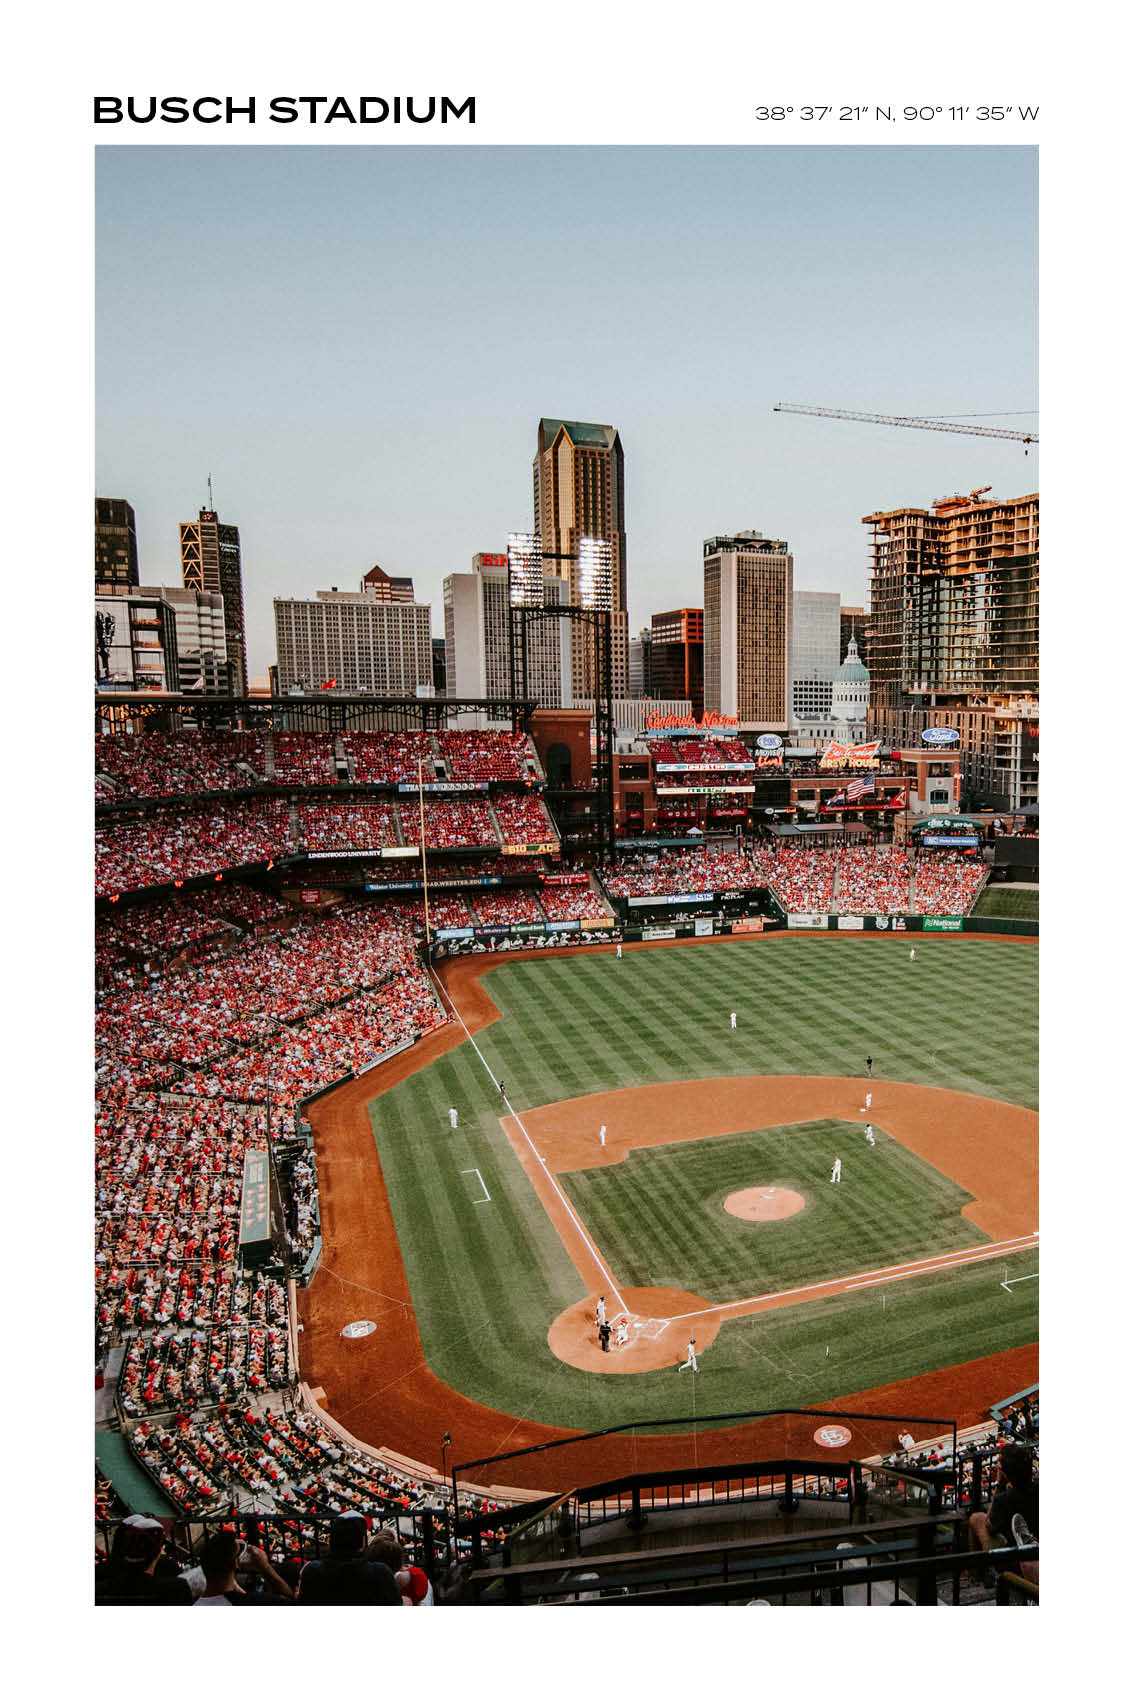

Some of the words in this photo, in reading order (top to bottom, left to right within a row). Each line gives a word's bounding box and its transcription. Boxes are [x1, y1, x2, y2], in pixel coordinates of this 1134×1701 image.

[647, 710, 697, 729] Cardinals
[697, 709, 738, 728] Nation
[928, 729, 952, 741] Ford
[848, 758, 880, 768] HOUSE
